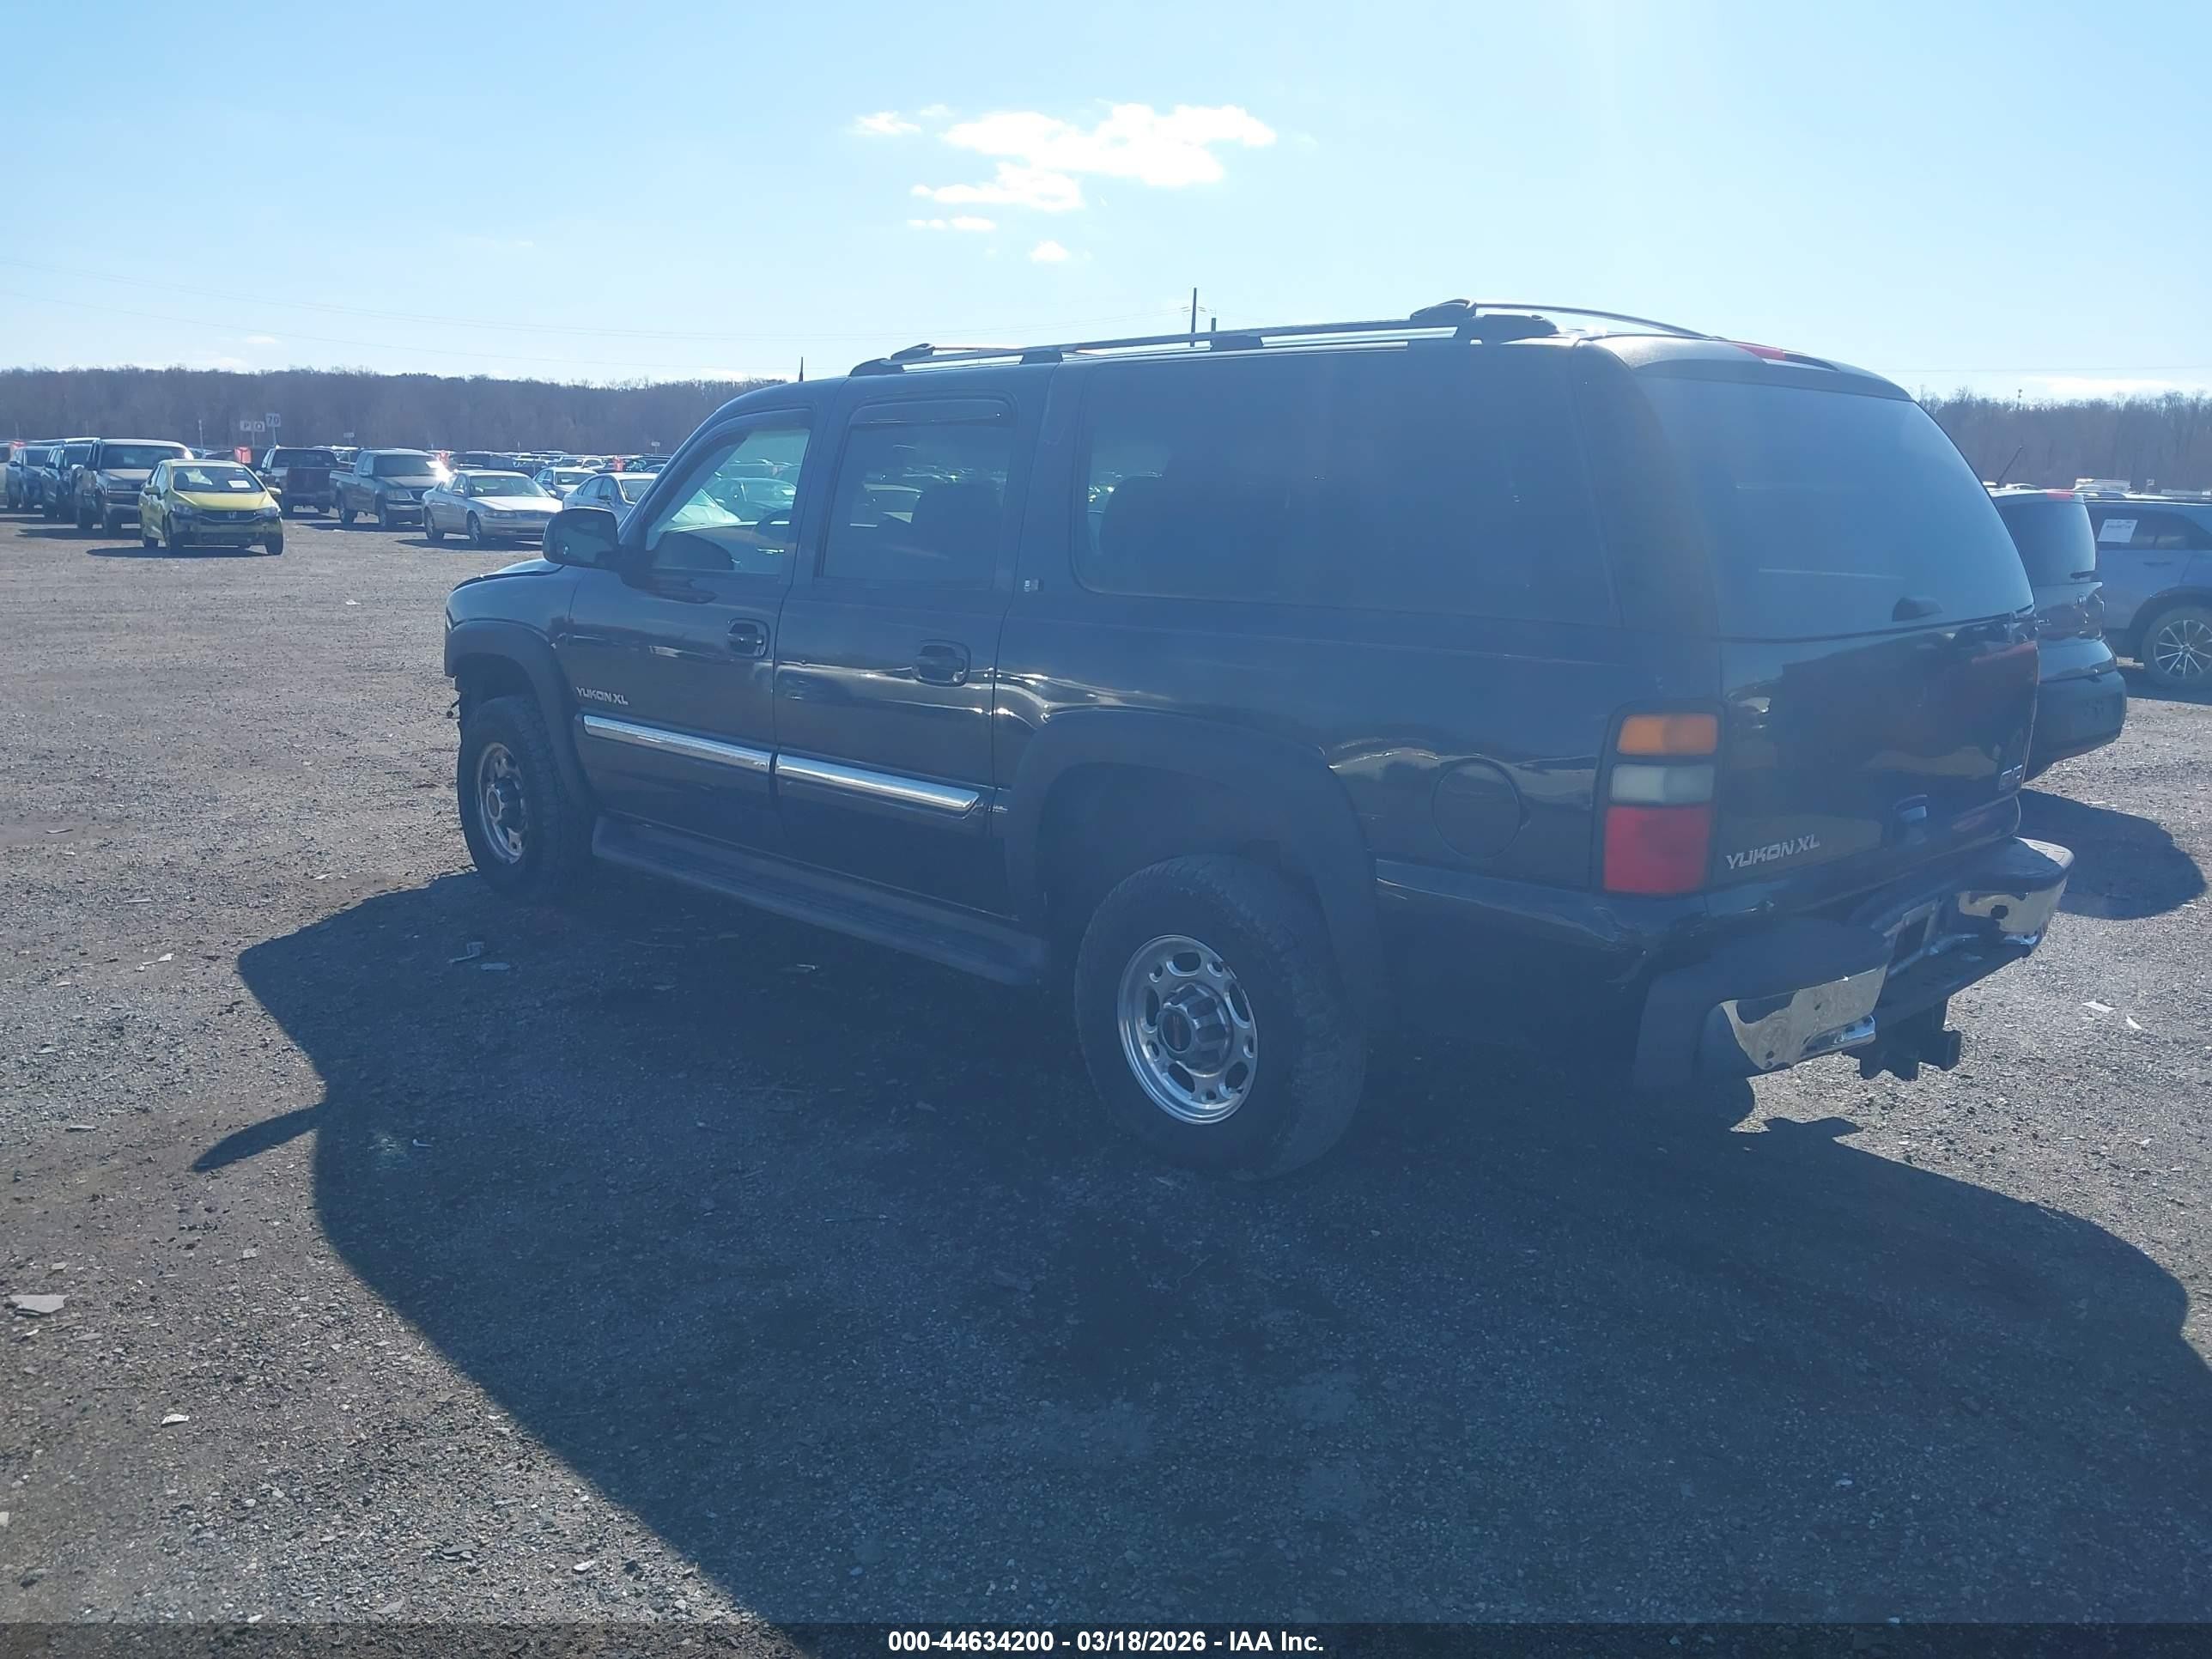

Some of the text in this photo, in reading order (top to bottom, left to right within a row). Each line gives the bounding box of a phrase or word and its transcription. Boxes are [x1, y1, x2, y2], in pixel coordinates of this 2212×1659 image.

[575, 687, 629, 706] YUKON XL
[1725, 834, 1820, 870] YUKON XL
